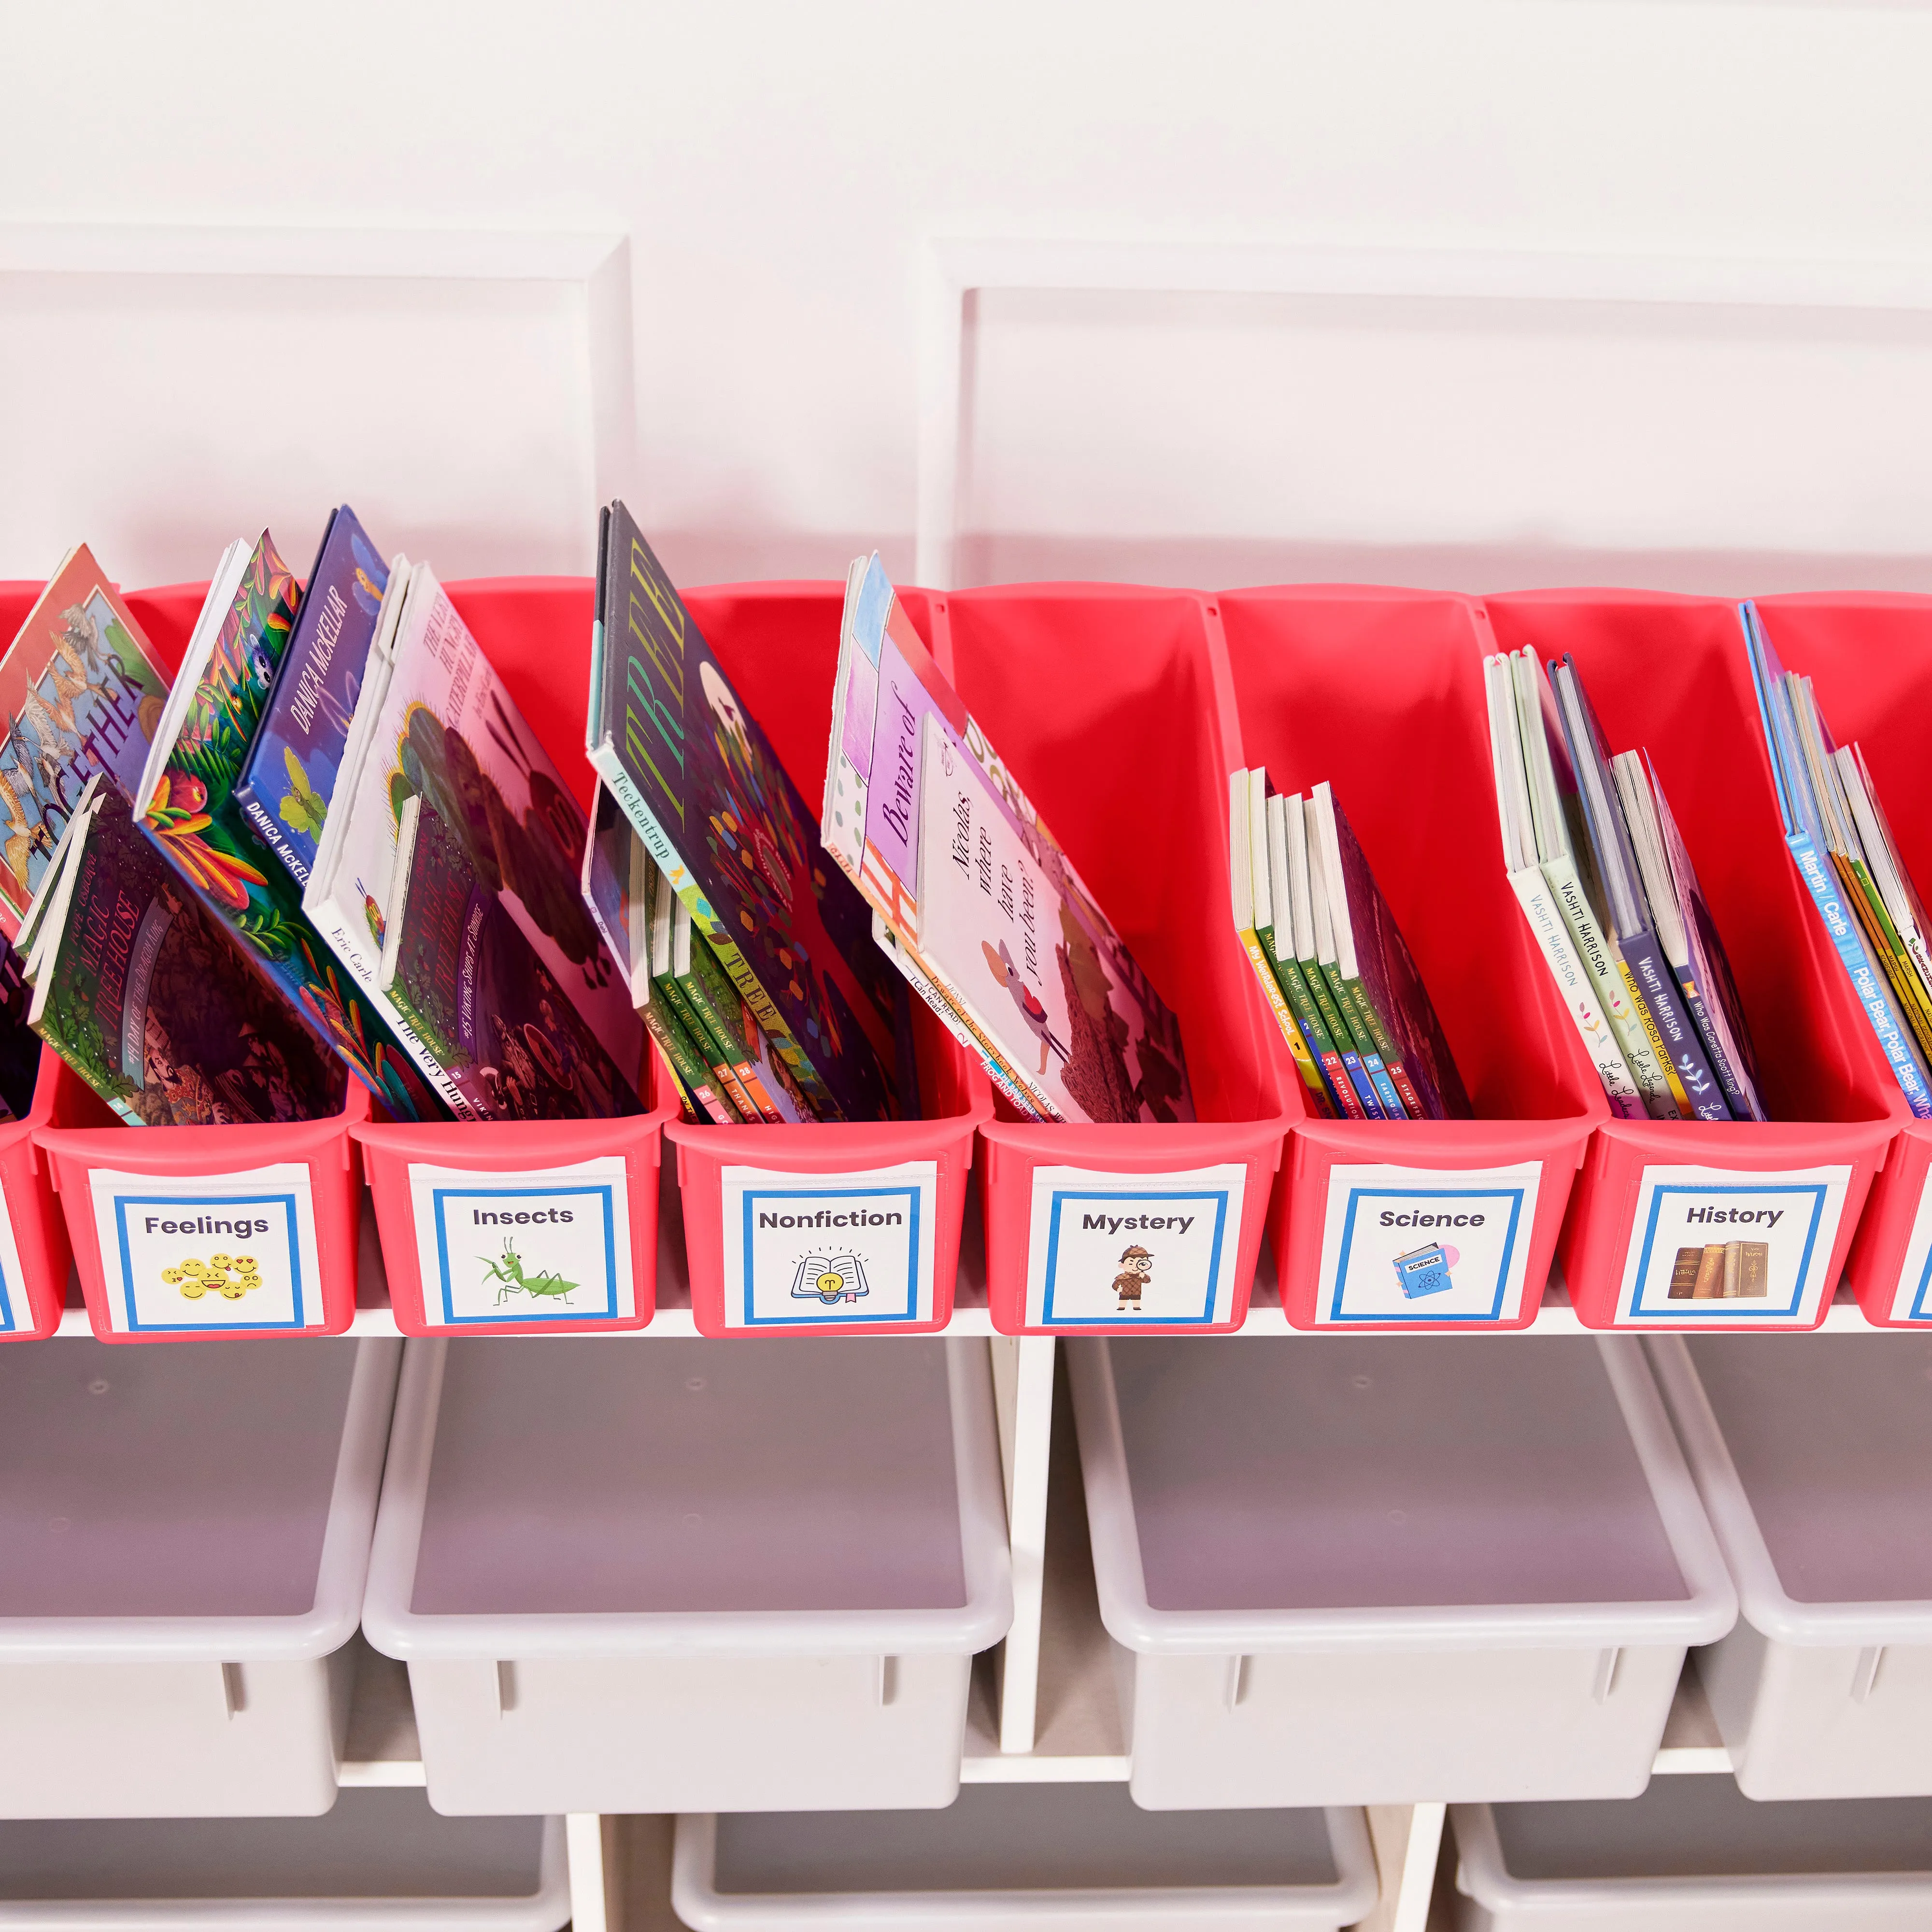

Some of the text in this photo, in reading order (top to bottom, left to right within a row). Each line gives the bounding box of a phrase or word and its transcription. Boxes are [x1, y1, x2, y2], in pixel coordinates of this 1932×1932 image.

[291, 663, 324, 735] DANICA
[625, 537, 686, 834] TREE
[882, 680, 915, 848] Beware of
[612, 772, 670, 859] Teckentrup
[952, 790, 973, 880] Nicolas,
[247, 802, 312, 888] DANICA McKELL
[975, 826, 992, 896] where
[69, 909, 84, 946] POPE
[77, 850, 97, 907] OSBORNE
[420, 871, 442, 944] MAGIC
[998, 865, 1014, 923] have
[1800, 850, 1847, 936] Martin Carle
[80, 894, 110, 977] MAGIC
[597, 921, 608, 934] Dahl
[1018, 860, 1042, 986] you been?
[1531, 895, 1578, 986] VASHTI HARRISON
[1561, 881, 1608, 976] VASHTI HARRISON
[331, 927, 373, 984] Eric Carle
[461, 902, 483, 1039] #15 VIKING SHIPS AT SUNRISE
[1880, 954, 1895, 980] SCHREIBER
[1889, 955, 1899, 972] MARSH
[1902, 961, 1914, 977] MARSH
[128, 919, 164, 1064] #14 DAY OF THE DRAGON KING
[664, 982, 683, 1008] MAGIC
[680, 1007, 696, 1026] TREE
[685, 981, 705, 1007] MAGIC
[701, 1006, 717, 1026] TREE
[724, 952, 777, 1022] TREE
[914, 981, 926, 995] Can
[925, 995, 944, 1015] Read!
[928, 987, 942, 1003] CAN
[941, 1003, 961, 1025] READ!
[945, 983, 966, 1006] LIONNI
[1249, 946, 1260, 960] My
[1278, 1005, 1296, 1037] School
[1287, 967, 1304, 992] MAGIC
[1298, 994, 1313, 1012] TREE
[1306, 967, 1322, 992] MAGIC
[1318, 993, 1332, 1013] TREE
[1329, 970, 1346, 995] MAGIC
[1341, 996, 1355, 1015] TREE
[1351, 986, 1368, 1009] MAGIC
[1364, 1010, 1377, 1028] TREE
[1638, 956, 1683, 1041] VASHTI HARRISON
[389, 990, 411, 1014] MAGIC
[408, 1013, 426, 1033] TREE
[644, 1011, 663, 1035] MAGIC
[660, 1034, 676, 1051] TREE
[1624, 971, 1677, 1076] Who Was Rosa Parks?
[1903, 1003, 1916, 1026] NATIONAL
[38, 1027, 63, 1051] MAGIC
[60, 1050, 78, 1065] TREE
[396, 1018, 420, 1045] The
[419, 1047, 445, 1079] Very
[931, 976, 956, 1006] Beware
[966, 1019, 977, 1031] the
[977, 1033, 1012, 1075] Storybook
[1013, 1075, 1035, 1103] Wolves
[957, 1032, 968, 1044] 2
[1294, 1042, 1301, 1051] 1
[1693, 1001, 1740, 1095] Who Was Coretta Scott King?
[1854, 967, 1932, 1120] Polar Bear, Polar Bear, Wha
[451, 1071, 462, 1080] 15
[718, 1069, 728, 1078] 27
[739, 1067, 751, 1076] 28
[1325, 1057, 1337, 1065] 22
[1346, 1056, 1356, 1065] 23
[1628, 1048, 1662, 1104] Little Legends
[473, 1097, 494, 1121] VIKIN
[682, 1096, 697, 1120] ON THE
[699, 1090, 711, 1099] 26
[732, 1089, 755, 1121] THANKS
[980, 1061, 1028, 1116] FROG AND TOAD
[999, 1071, 1036, 1116] THE BAD SEED
[1336, 1077, 1359, 1120] REVOLUTION
[1364, 1094, 1380, 1120] TWIST
[1380, 1082, 1399, 1120] EARTHQUAK
[1401, 1084, 1416, 1105] STAGE
[1599, 1060, 1634, 1119] Little Leaders
[145, 1216, 269, 1239] Feelings
[473, 1206, 574, 1225] Insects
[760, 1209, 902, 1228] Nonfiction
[1082, 1214, 1195, 1235] Mystery
[1379, 1209, 1485, 1227] Science
[1687, 1206, 1784, 1228] History
[1408, 1257, 1440, 1270] SCIENCE
